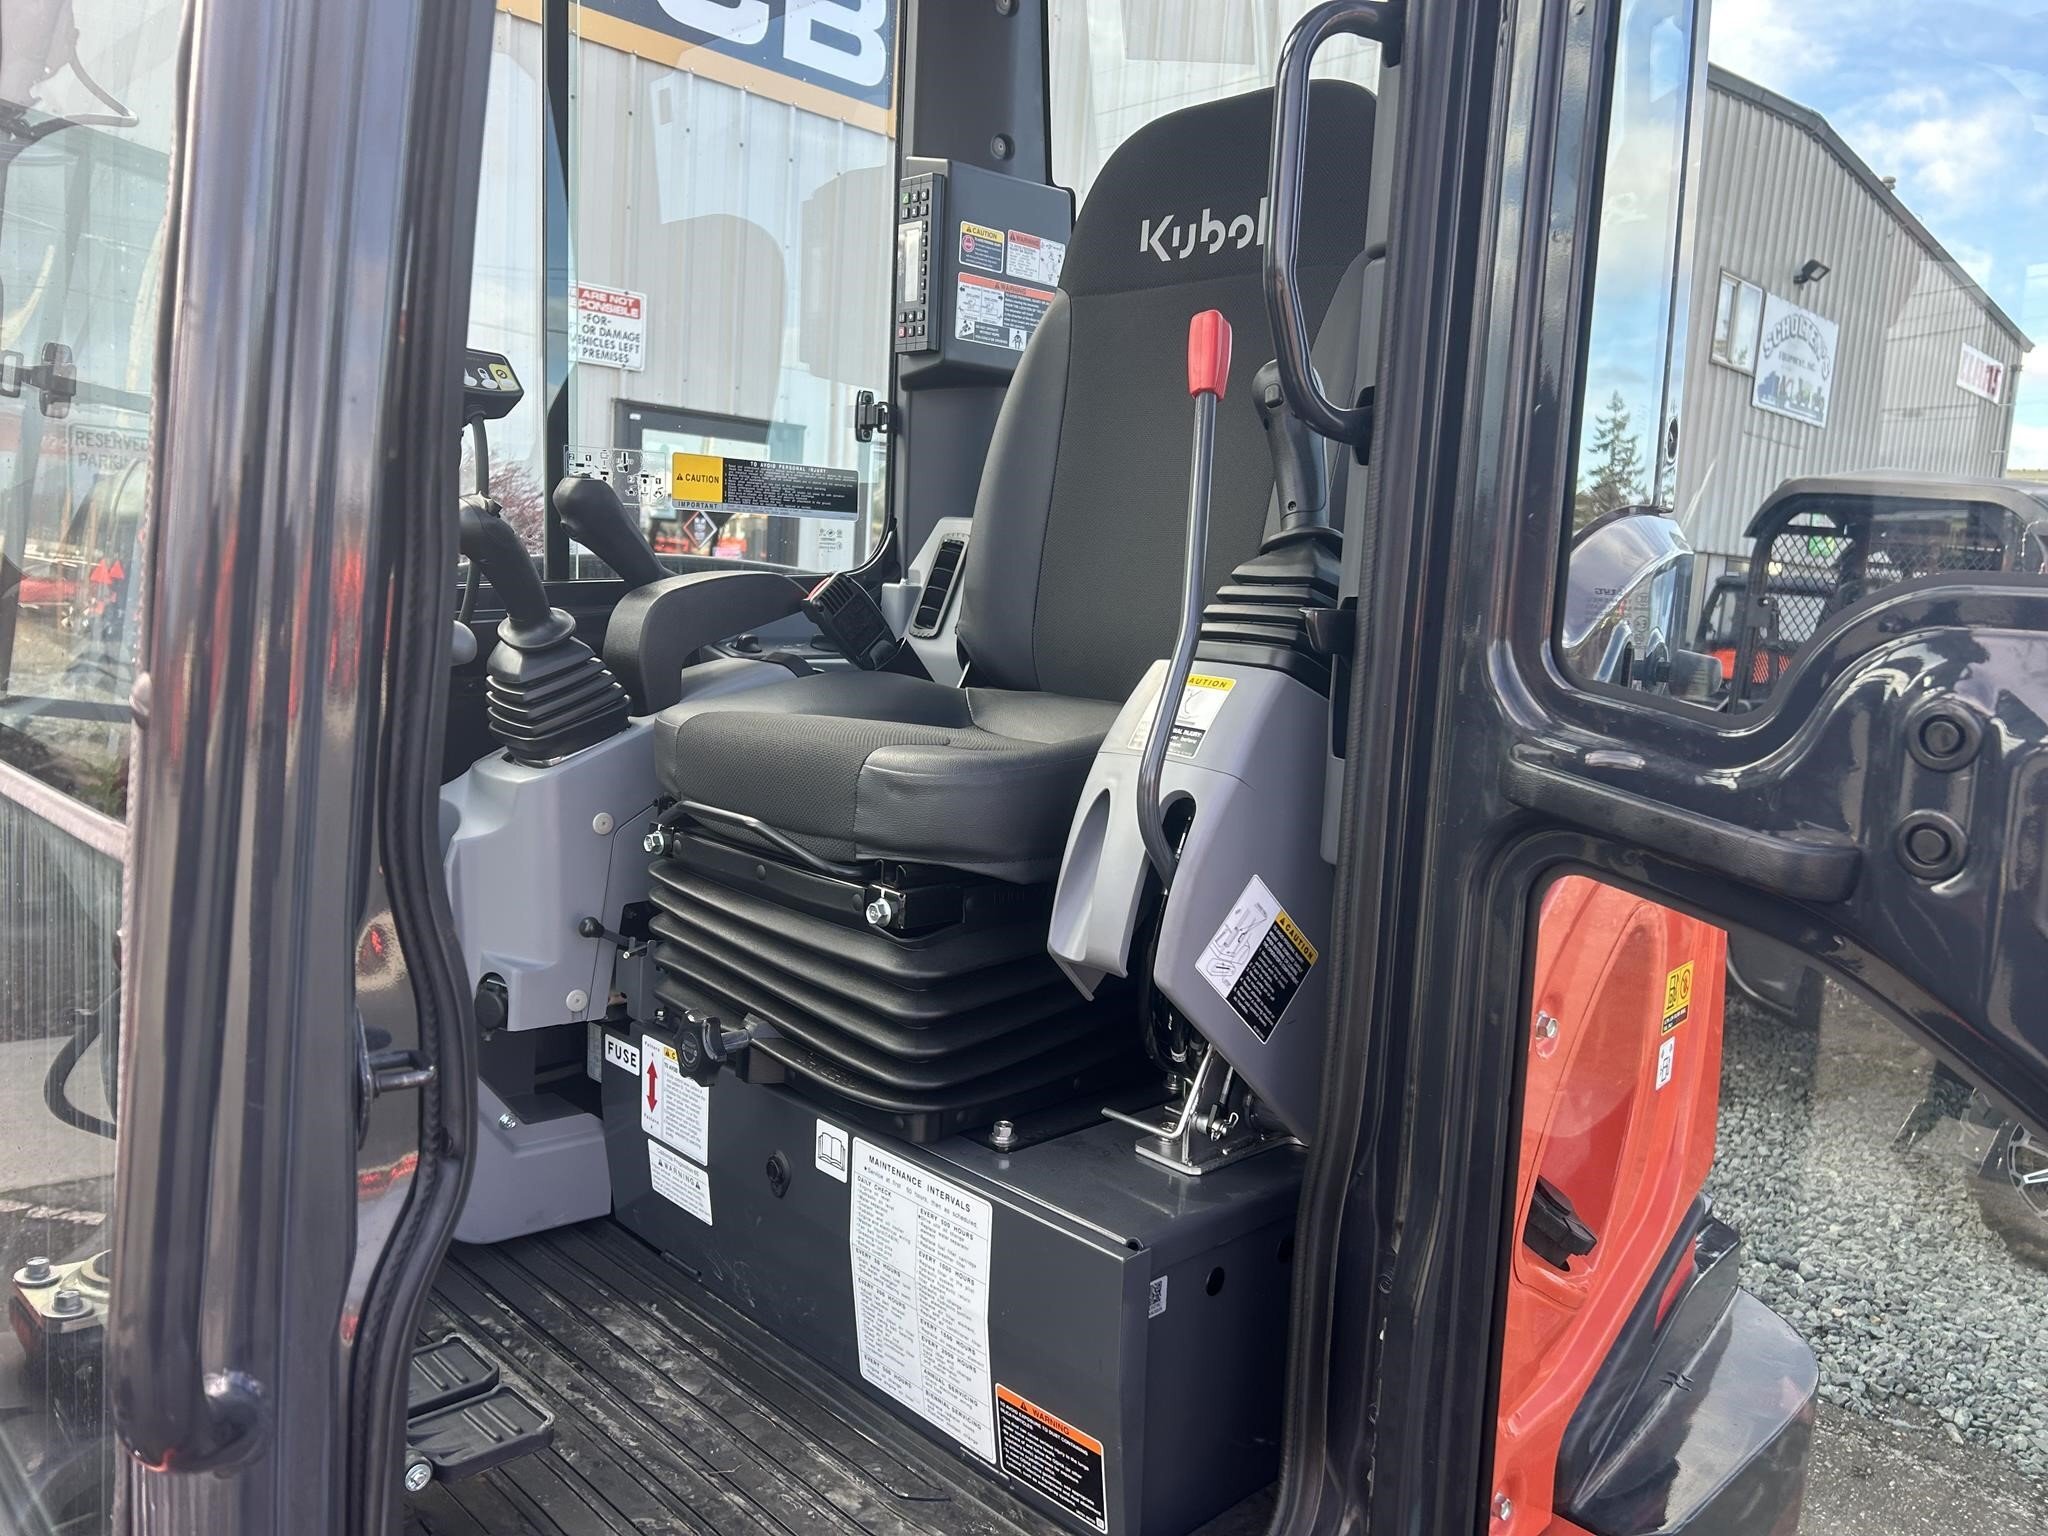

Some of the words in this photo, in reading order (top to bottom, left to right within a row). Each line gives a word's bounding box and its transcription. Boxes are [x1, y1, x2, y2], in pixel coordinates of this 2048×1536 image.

[972, 227, 998, 240] CAUTION
[581, 290, 607, 303] ARE
[609, 295, 635, 307] NOT
[578, 299, 639, 318] PONSIBLE
[582, 324, 596, 336] OR
[599, 327, 641, 343] DAMAGE
[582, 347, 630, 364] PREMISES
[618, 341, 640, 354] LEFT
[779, 464, 806, 472] PERSONAL
[685, 473, 720, 484] CAUTION
[677, 501, 718, 509] IMPORTANT
[1188, 677, 1228, 688] AUTION
[1285, 924, 1314, 961] CAUTION
[607, 1040, 637, 1068] FUSE
[664, 1161, 696, 1187] WARNING
[868, 1154, 922, 1188] MAINTENANCE
[927, 1183, 970, 1212] INTERVALS
[1032, 1408, 1069, 1435] WARNING
